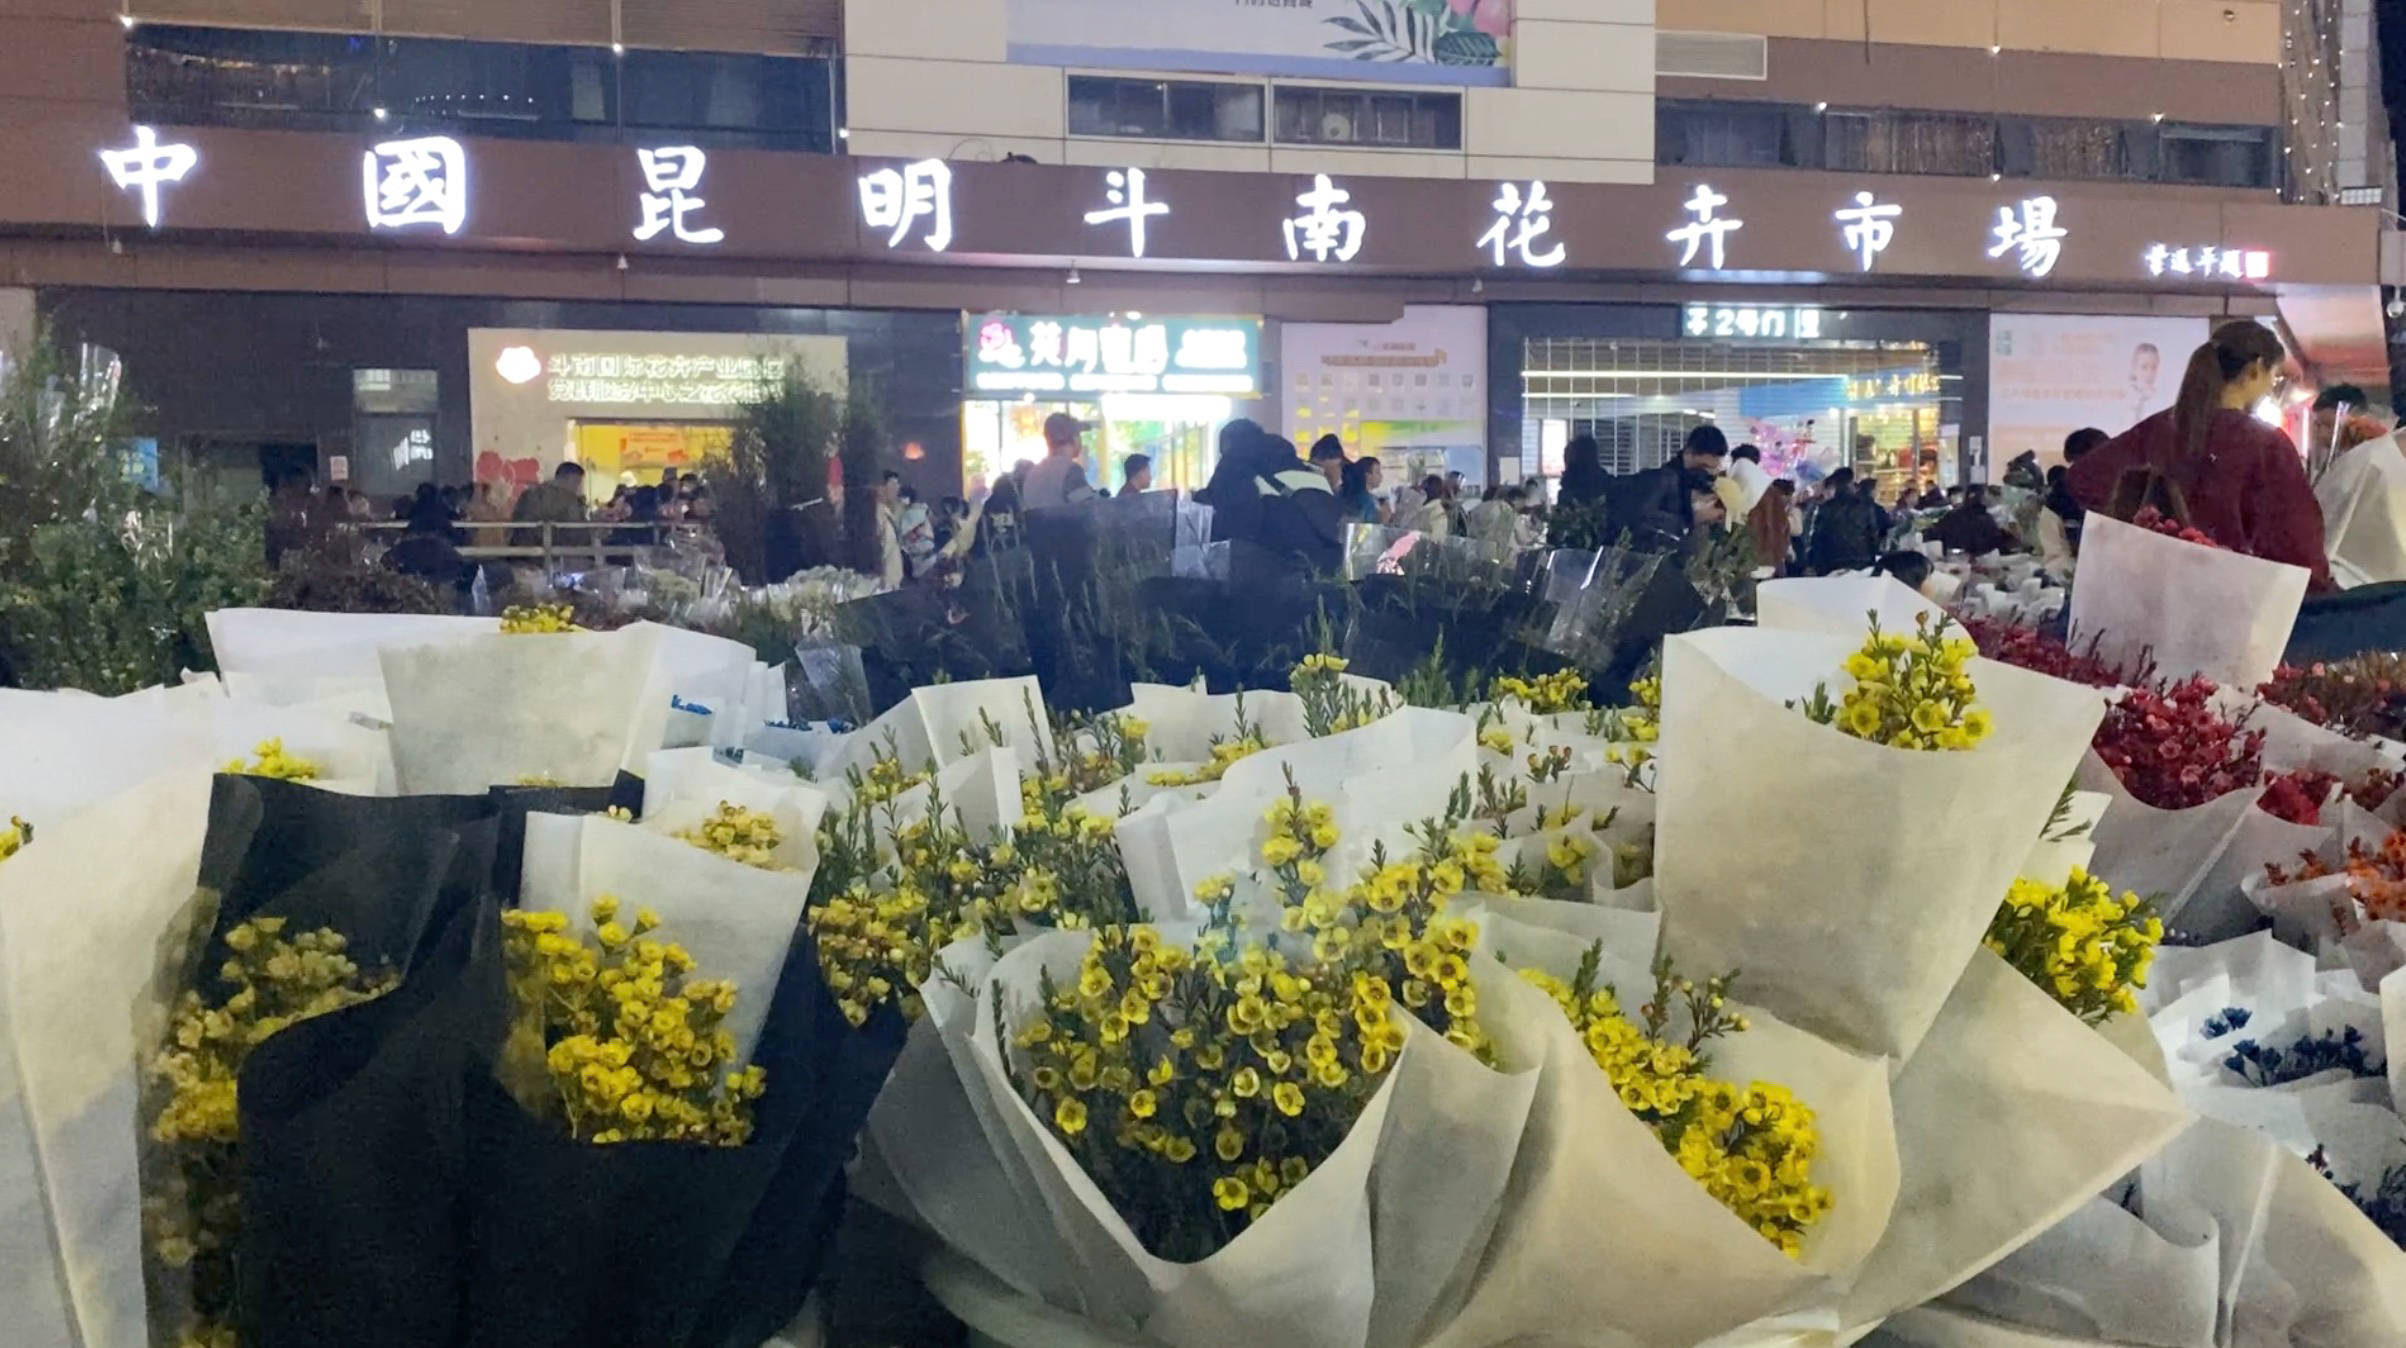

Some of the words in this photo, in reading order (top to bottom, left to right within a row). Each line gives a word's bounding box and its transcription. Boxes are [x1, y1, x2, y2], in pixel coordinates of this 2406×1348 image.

[100, 124, 2069, 278] 中國昆明斗南花卉市場
